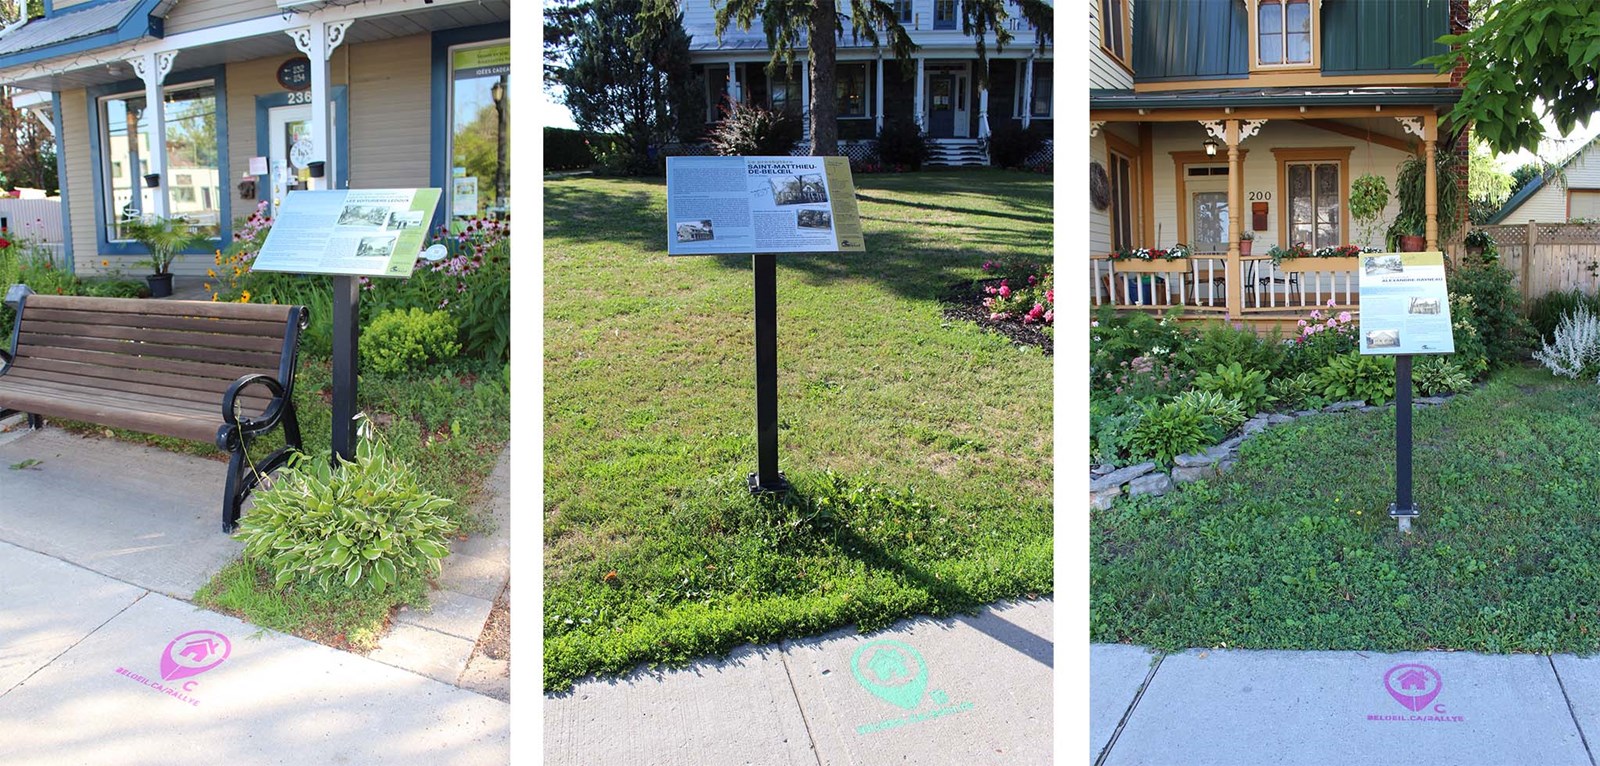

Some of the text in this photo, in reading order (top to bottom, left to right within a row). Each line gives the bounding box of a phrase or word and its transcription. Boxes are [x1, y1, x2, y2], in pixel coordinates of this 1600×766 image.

[287, 91, 311, 104] 236
[1249, 191, 1271, 201] 200
[115, 667, 201, 707] BELOEIL.CA/RALLYE
[182, 681, 199, 692] C
[1433, 703, 1447, 714] C
[1367, 714, 1465, 722] BELOEIL.CA/RALLYE
